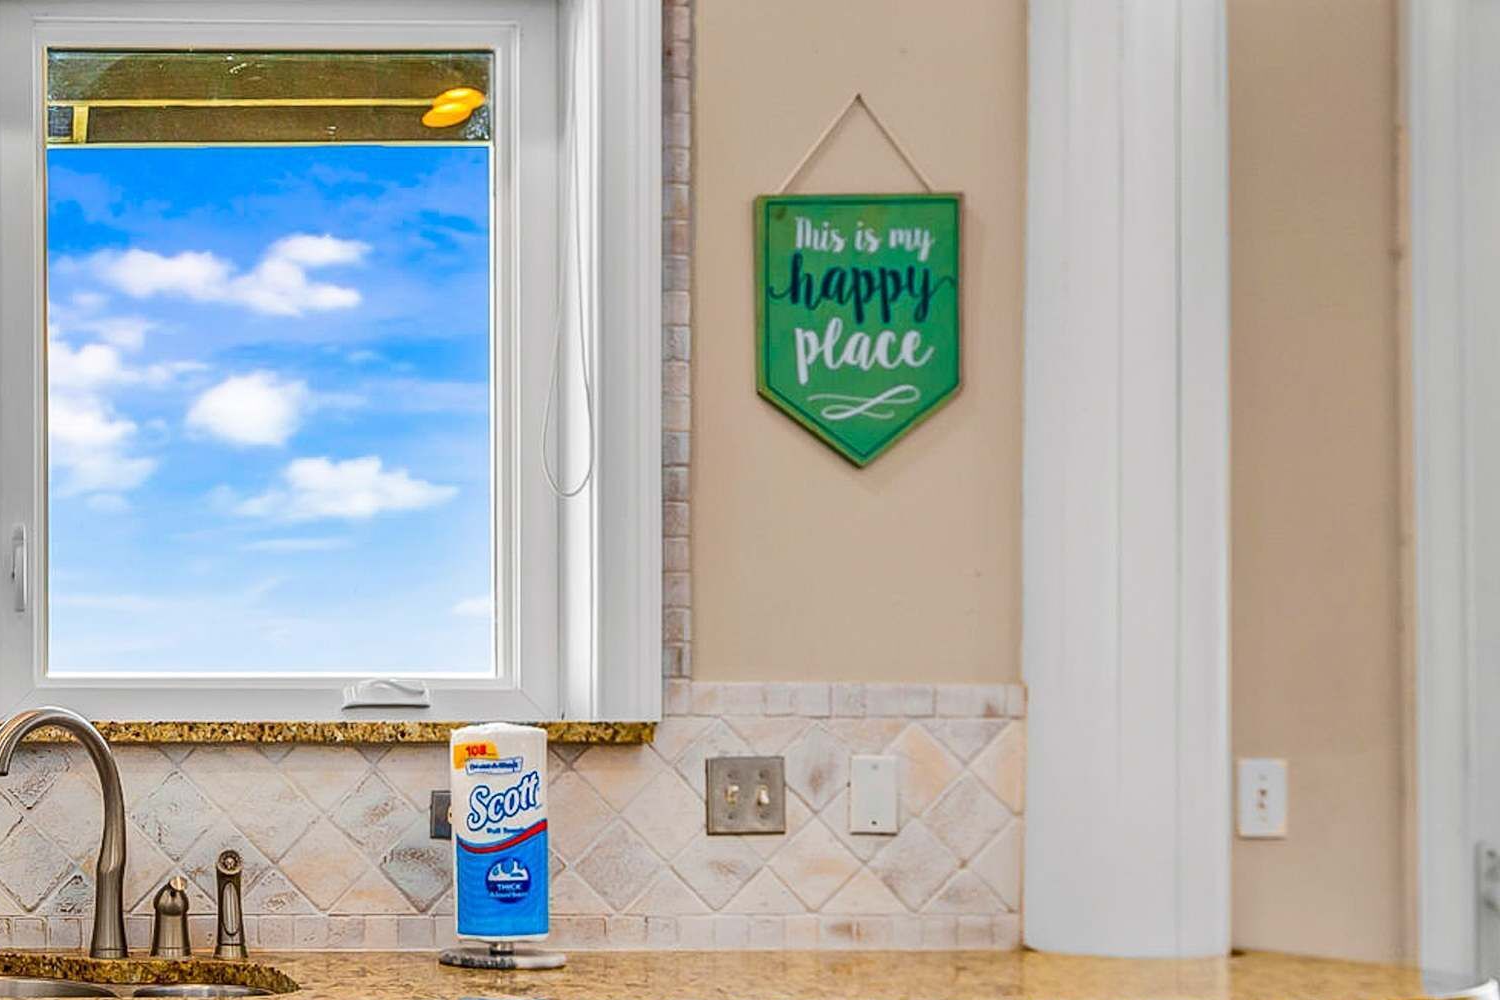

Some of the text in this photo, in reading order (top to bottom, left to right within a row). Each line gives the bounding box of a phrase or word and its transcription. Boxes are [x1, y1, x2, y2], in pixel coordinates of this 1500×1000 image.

[794, 216, 935, 262] This is my
[768, 252, 957, 324] happy
[793, 317, 935, 386] place
[467, 770, 539, 831] Scott
